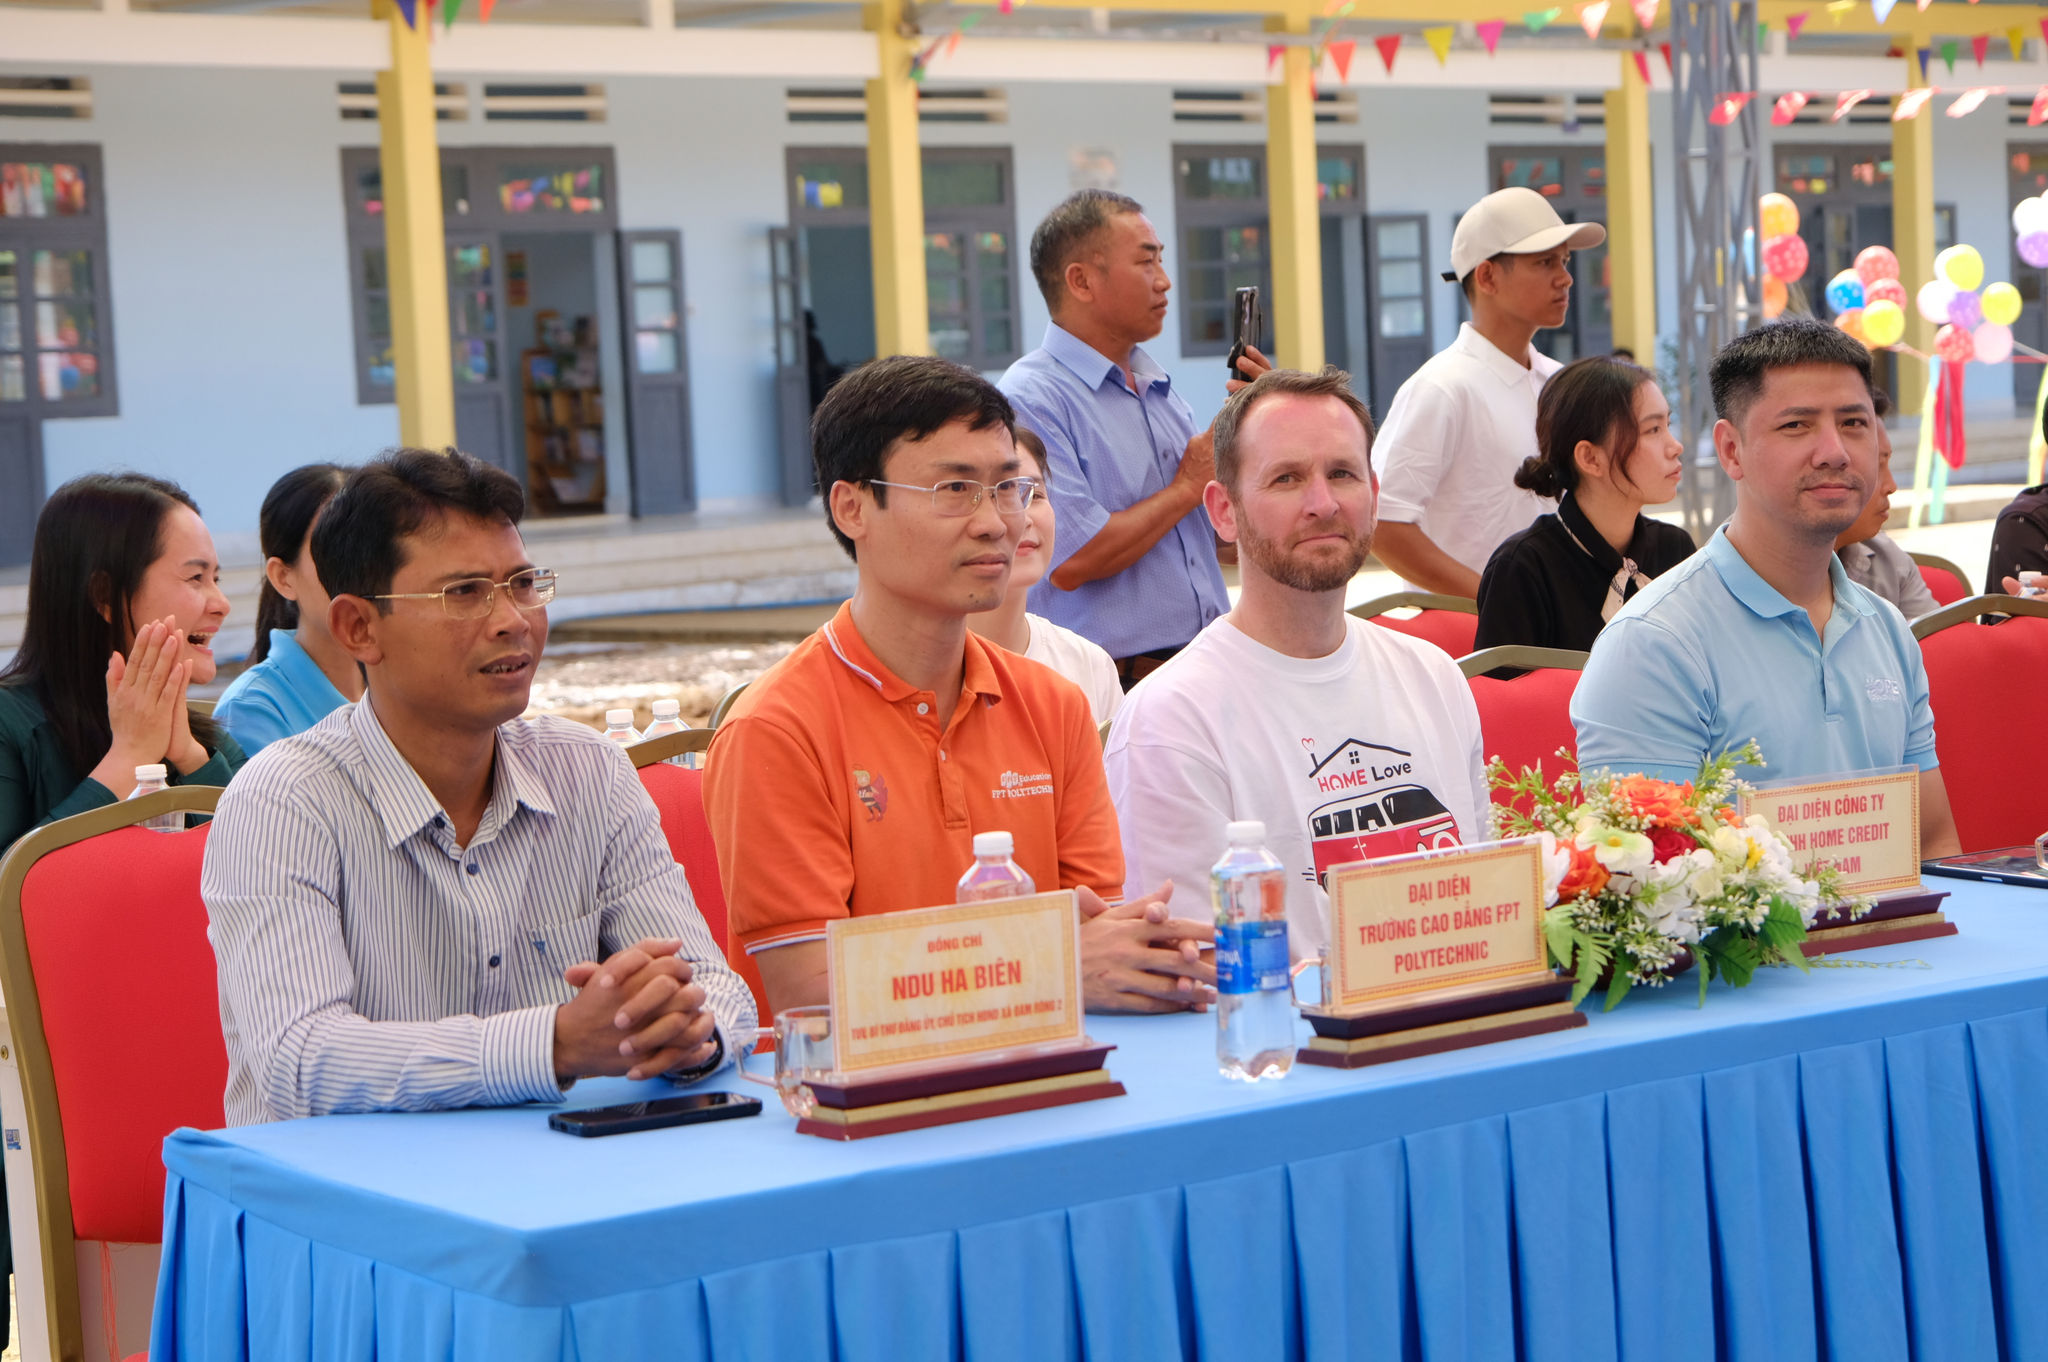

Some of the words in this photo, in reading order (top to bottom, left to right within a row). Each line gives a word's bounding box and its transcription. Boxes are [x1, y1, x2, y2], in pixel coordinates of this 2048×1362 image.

[1007, 784, 1054, 799] POLYTECHN
[1317, 768, 1368, 793] HOME
[1371, 762, 1411, 782] Love
[1777, 804, 1799, 826] ĐẠI
[1803, 798, 1831, 822] DIỆN
[1834, 794, 1867, 816] CÔNG
[1871, 793, 1885, 812] TY
[1786, 833, 1806, 851] HH
[1810, 828, 1844, 849] HOME
[1848, 822, 1890, 844] CREDIT
[1408, 881, 1433, 906] ĐẠI
[1437, 873, 1471, 901] DIỆN
[1359, 917, 1417, 945] TRƯỜNG
[1421, 913, 1449, 935] CAO
[1496, 902, 1521, 923] FPT
[1394, 940, 1489, 974] POLYTECHNIC
[892, 972, 934, 1001] NDU
[941, 967, 969, 994] HA
[974, 957, 1022, 990] BIÊN
